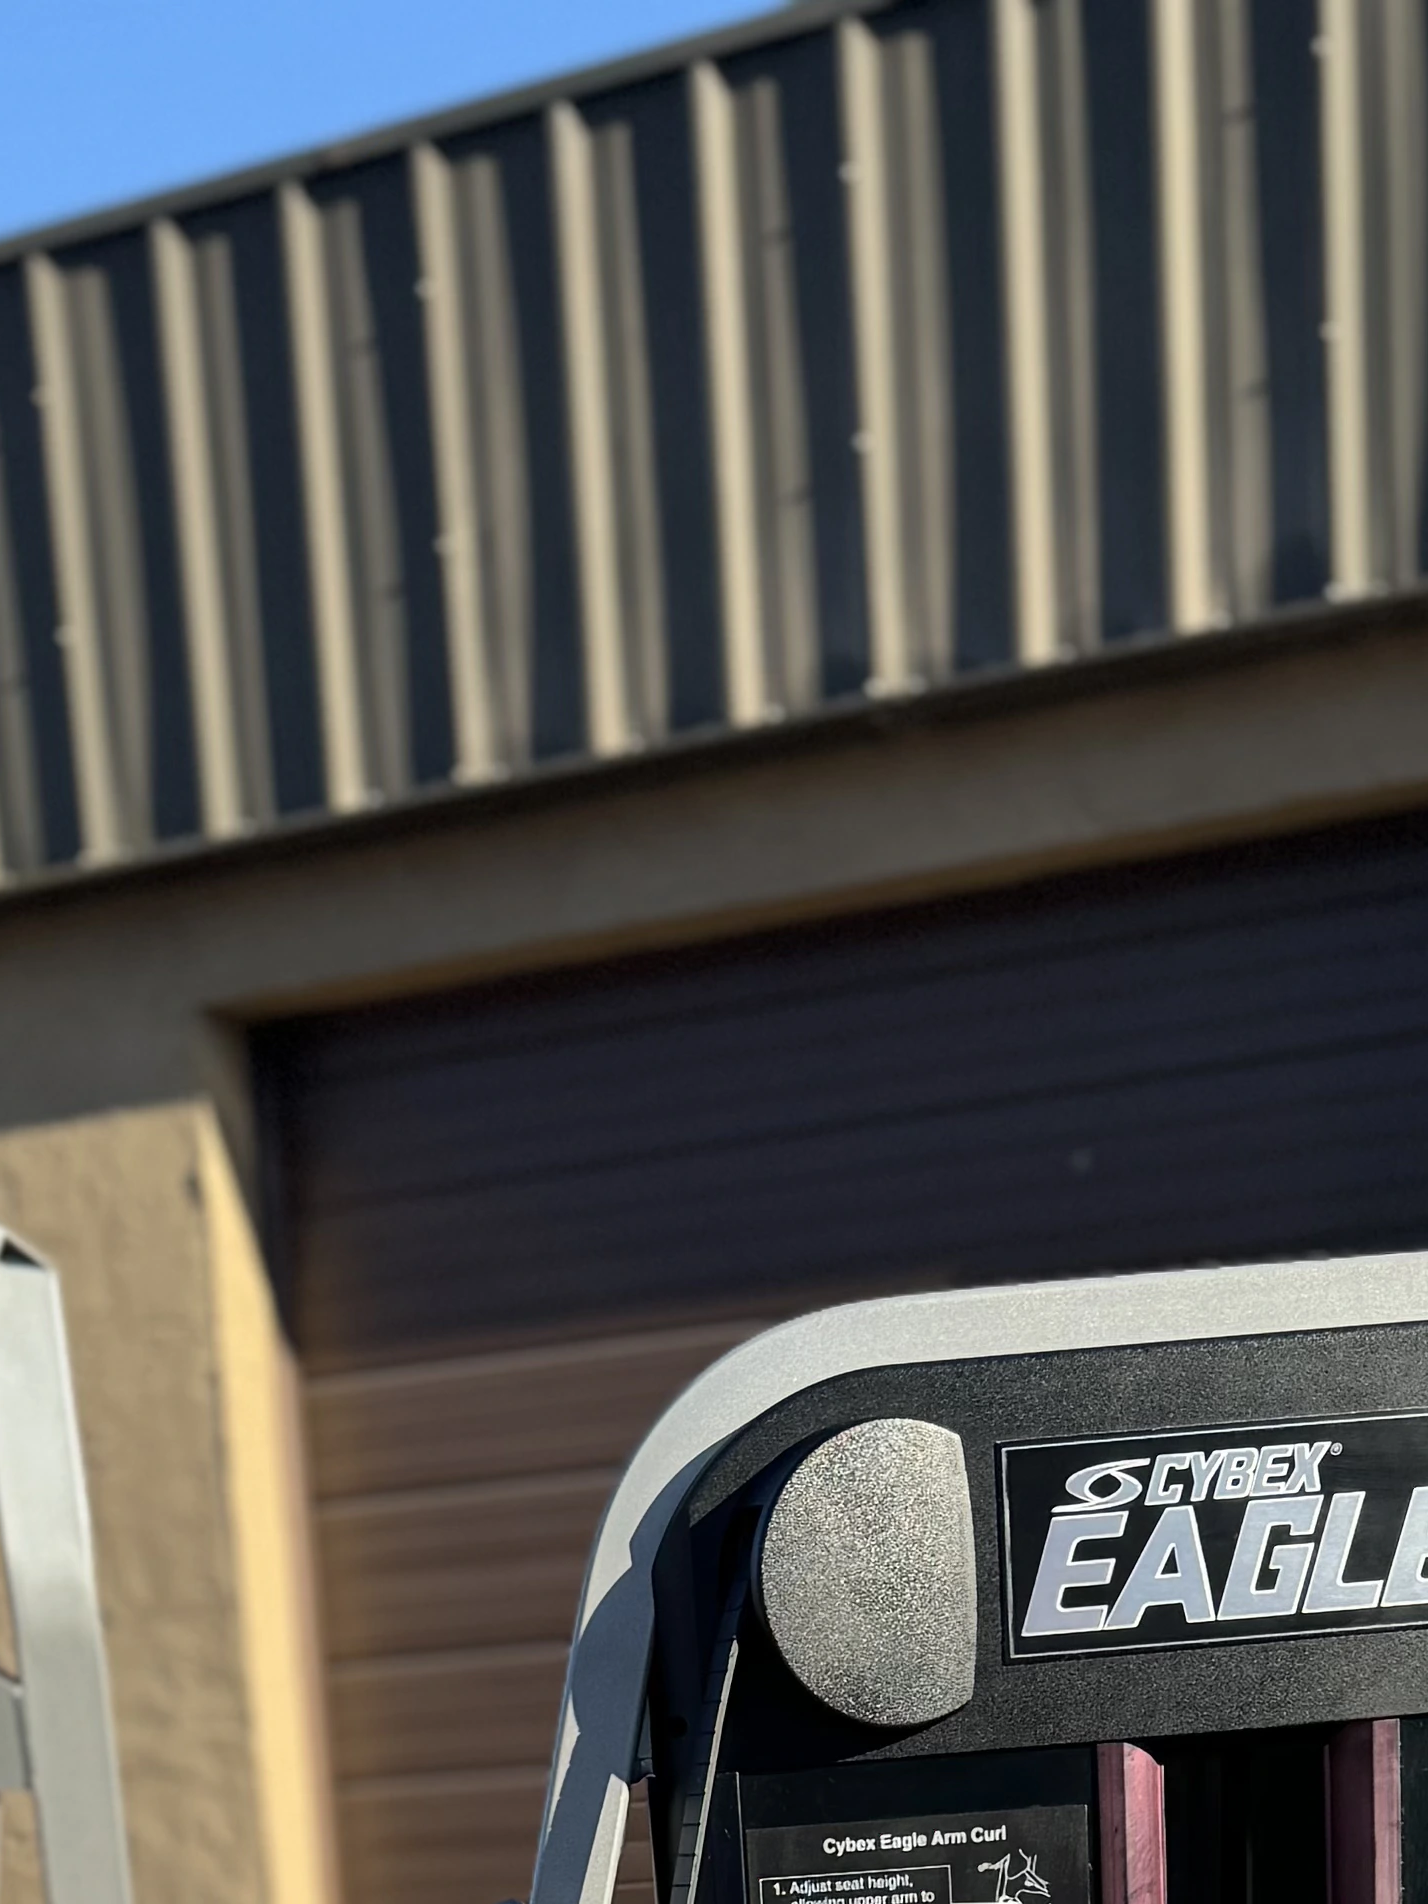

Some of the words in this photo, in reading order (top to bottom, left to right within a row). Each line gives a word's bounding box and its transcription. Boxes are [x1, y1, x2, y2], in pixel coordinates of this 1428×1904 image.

[823, 1837, 875, 1857] Cybex
[880, 1833, 927, 1850] Eagle
[932, 1831, 966, 1846] Arm
[971, 1825, 1006, 1842] Curl
[774, 1884, 786, 1896] 1.
[790, 1879, 833, 1896] Adjust
[835, 1878, 864, 1892] seat
[868, 1874, 913, 1891] height,
[891, 1894, 918, 1904] arm
[921, 1890, 935, 1903] to
